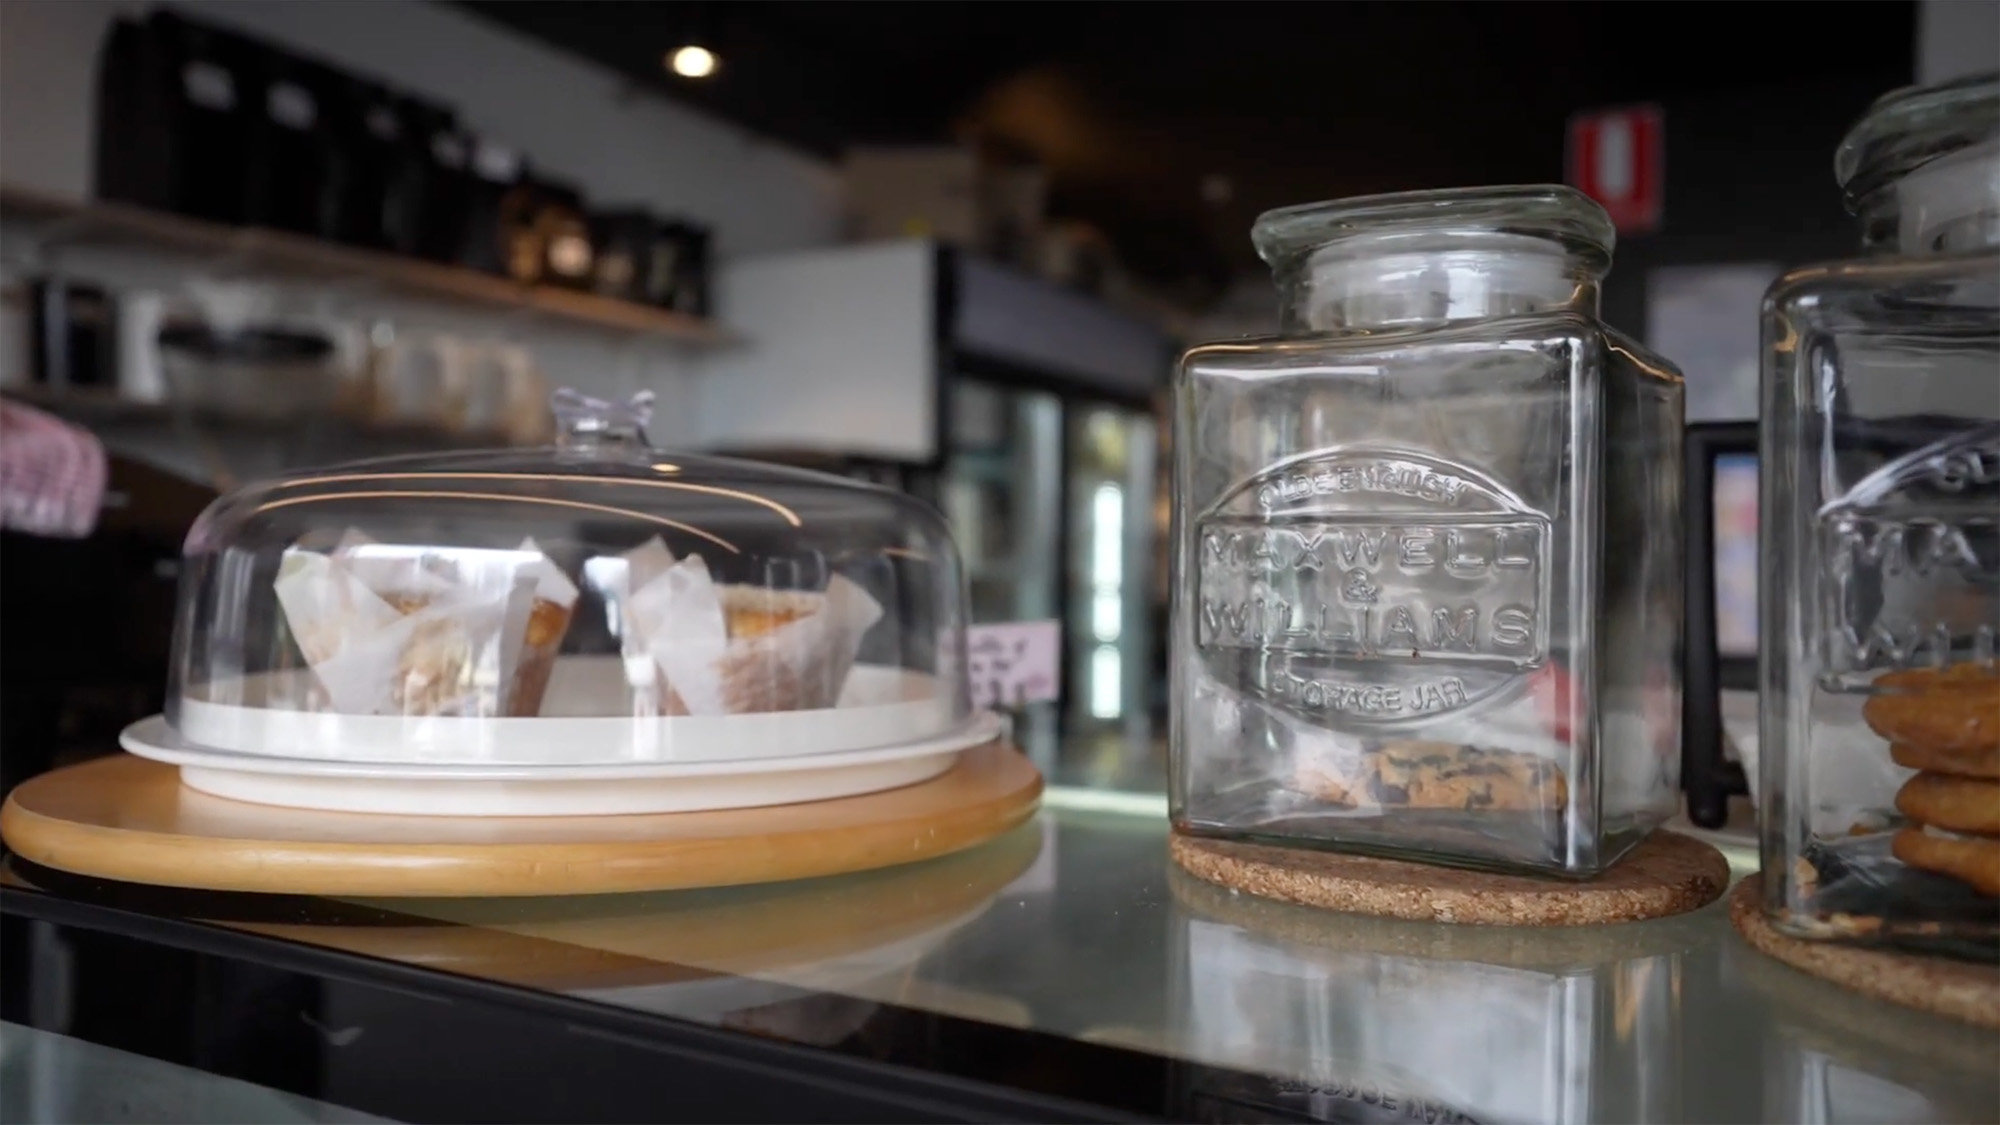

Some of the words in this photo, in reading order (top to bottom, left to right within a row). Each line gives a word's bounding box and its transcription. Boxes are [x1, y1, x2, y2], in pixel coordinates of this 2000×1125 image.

[1203, 529, 1531, 570] MAXWELL
[1344, 567, 1380, 603] &
[1203, 599, 1532, 648] WILLIAMS
[1271, 670, 1402, 713] STORAGE
[1408, 675, 1469, 712] JAR
